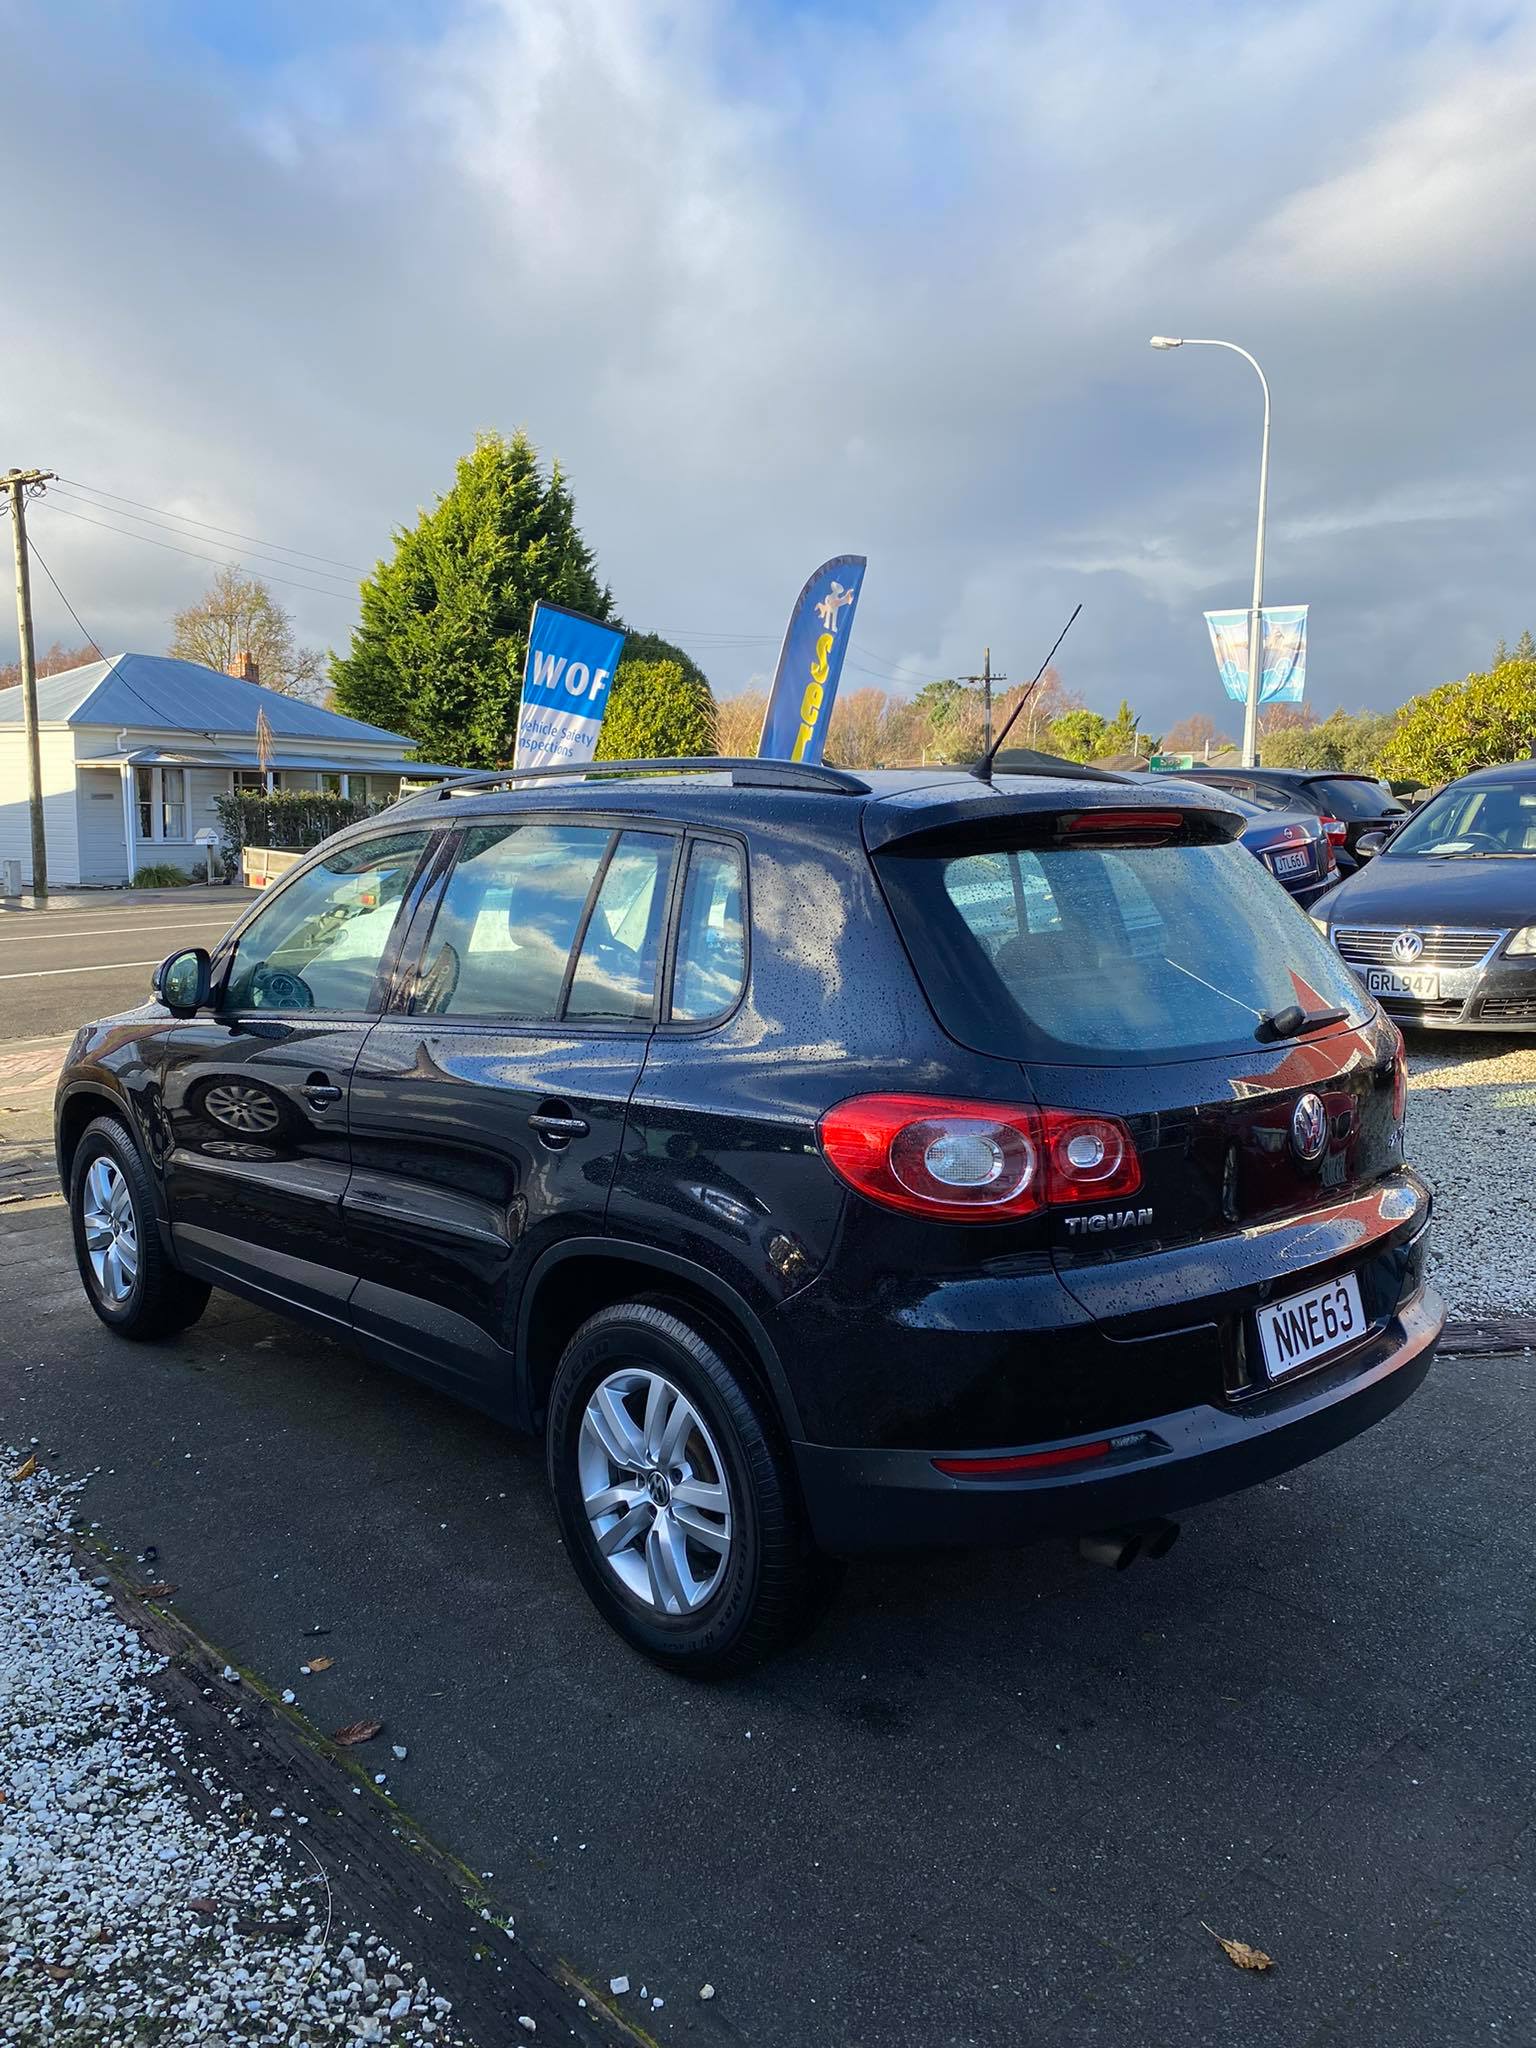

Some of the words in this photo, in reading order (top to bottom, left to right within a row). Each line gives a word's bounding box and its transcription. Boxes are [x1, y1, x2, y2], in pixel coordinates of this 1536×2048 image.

[533, 650, 610, 701] WOF
[519, 737, 574, 757] nspections
[560, 727, 594, 748] Safety
[1277, 850, 1305, 871] JTL661
[1370, 973, 1434, 993] GRL947
[1064, 1207, 1153, 1236] TIGUAN
[1272, 1288, 1353, 1362] NNE63
